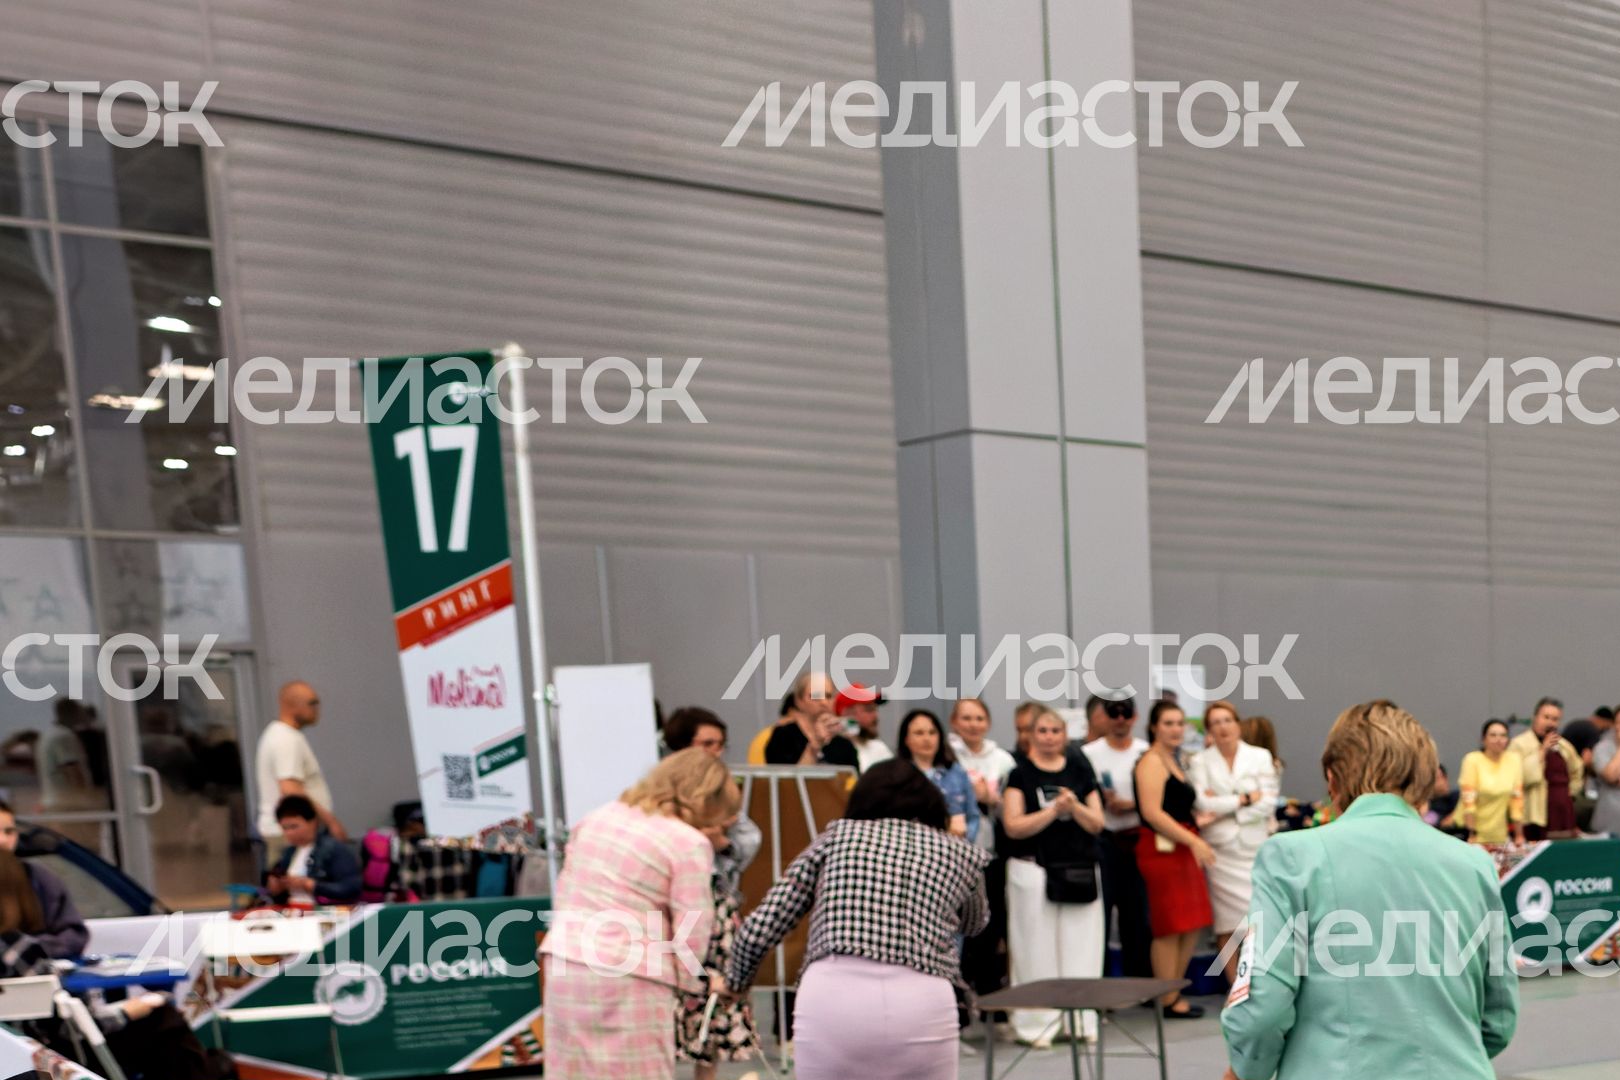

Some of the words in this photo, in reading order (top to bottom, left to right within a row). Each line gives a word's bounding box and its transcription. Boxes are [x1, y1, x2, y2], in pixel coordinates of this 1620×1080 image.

[393, 423, 480, 553] 17
[421, 578, 491, 629] РИНГ
[1553, 876, 1613, 896] РОССИЯ
[390, 956, 508, 985] РОССИЯ
